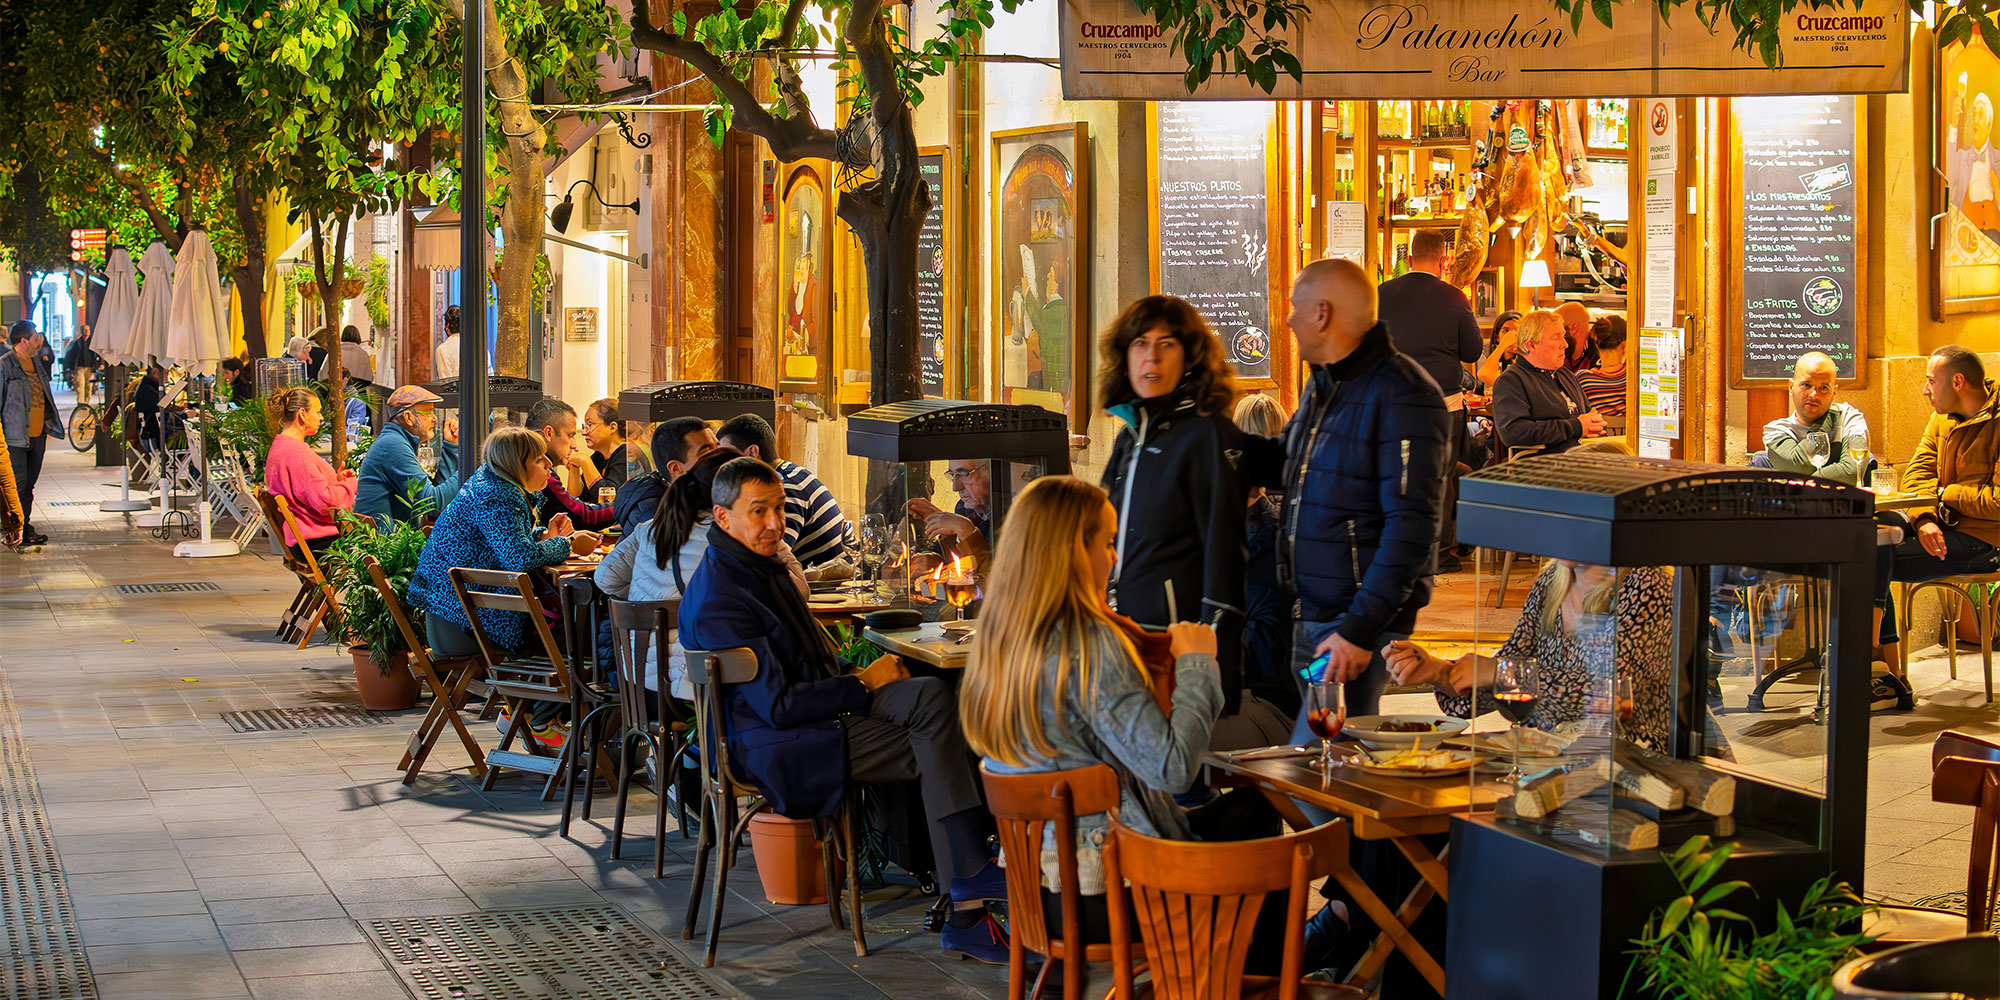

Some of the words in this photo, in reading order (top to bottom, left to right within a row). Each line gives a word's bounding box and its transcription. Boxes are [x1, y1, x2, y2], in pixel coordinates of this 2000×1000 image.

[1081, 22, 1162, 41] Cruzcampo
[1355, 3, 1568, 50] Patanchón
[1797, 14, 1884, 33] Cruzcampo
[1448, 56, 1505, 82] Bar
[1163, 181, 1207, 192] NUESTROS
[1751, 190, 1767, 201] LOS
[1747, 299, 1764, 309] LOS
[1764, 298, 1798, 308] FRITOS
